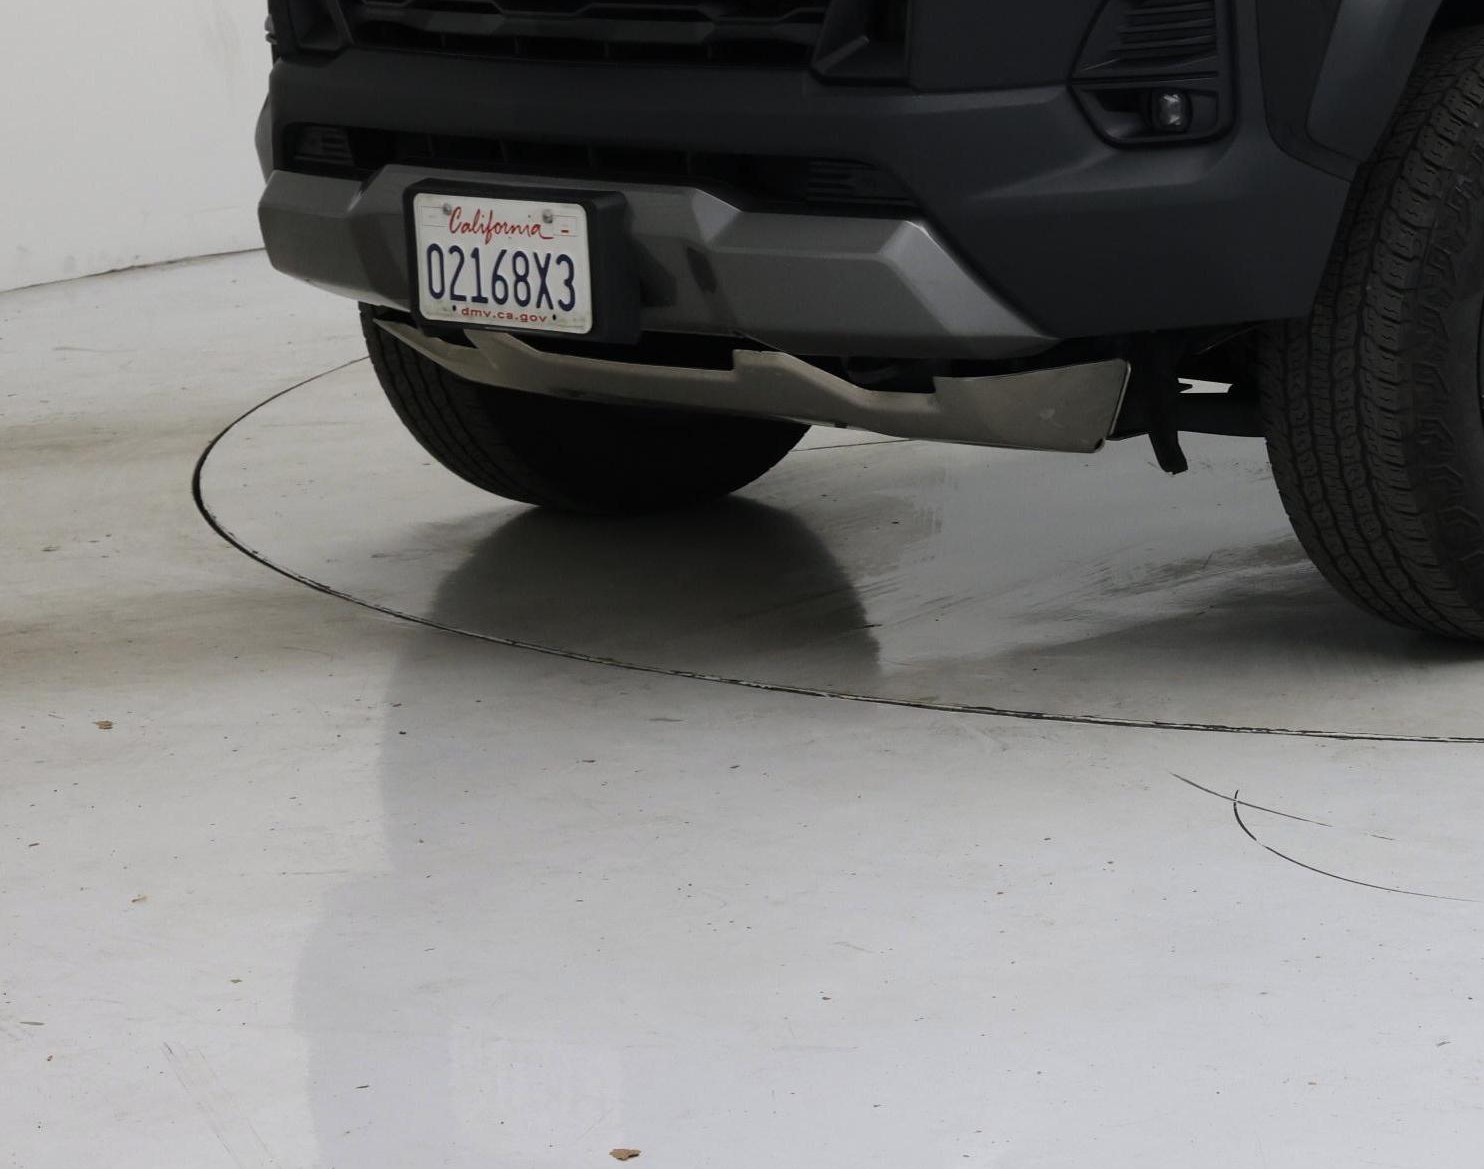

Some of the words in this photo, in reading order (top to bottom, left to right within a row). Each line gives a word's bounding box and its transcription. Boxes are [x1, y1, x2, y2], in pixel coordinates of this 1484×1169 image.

[449, 206, 554, 245] California
[426, 243, 576, 312] 02168X3
[461, 307, 548, 323] dmv.ca.gov
